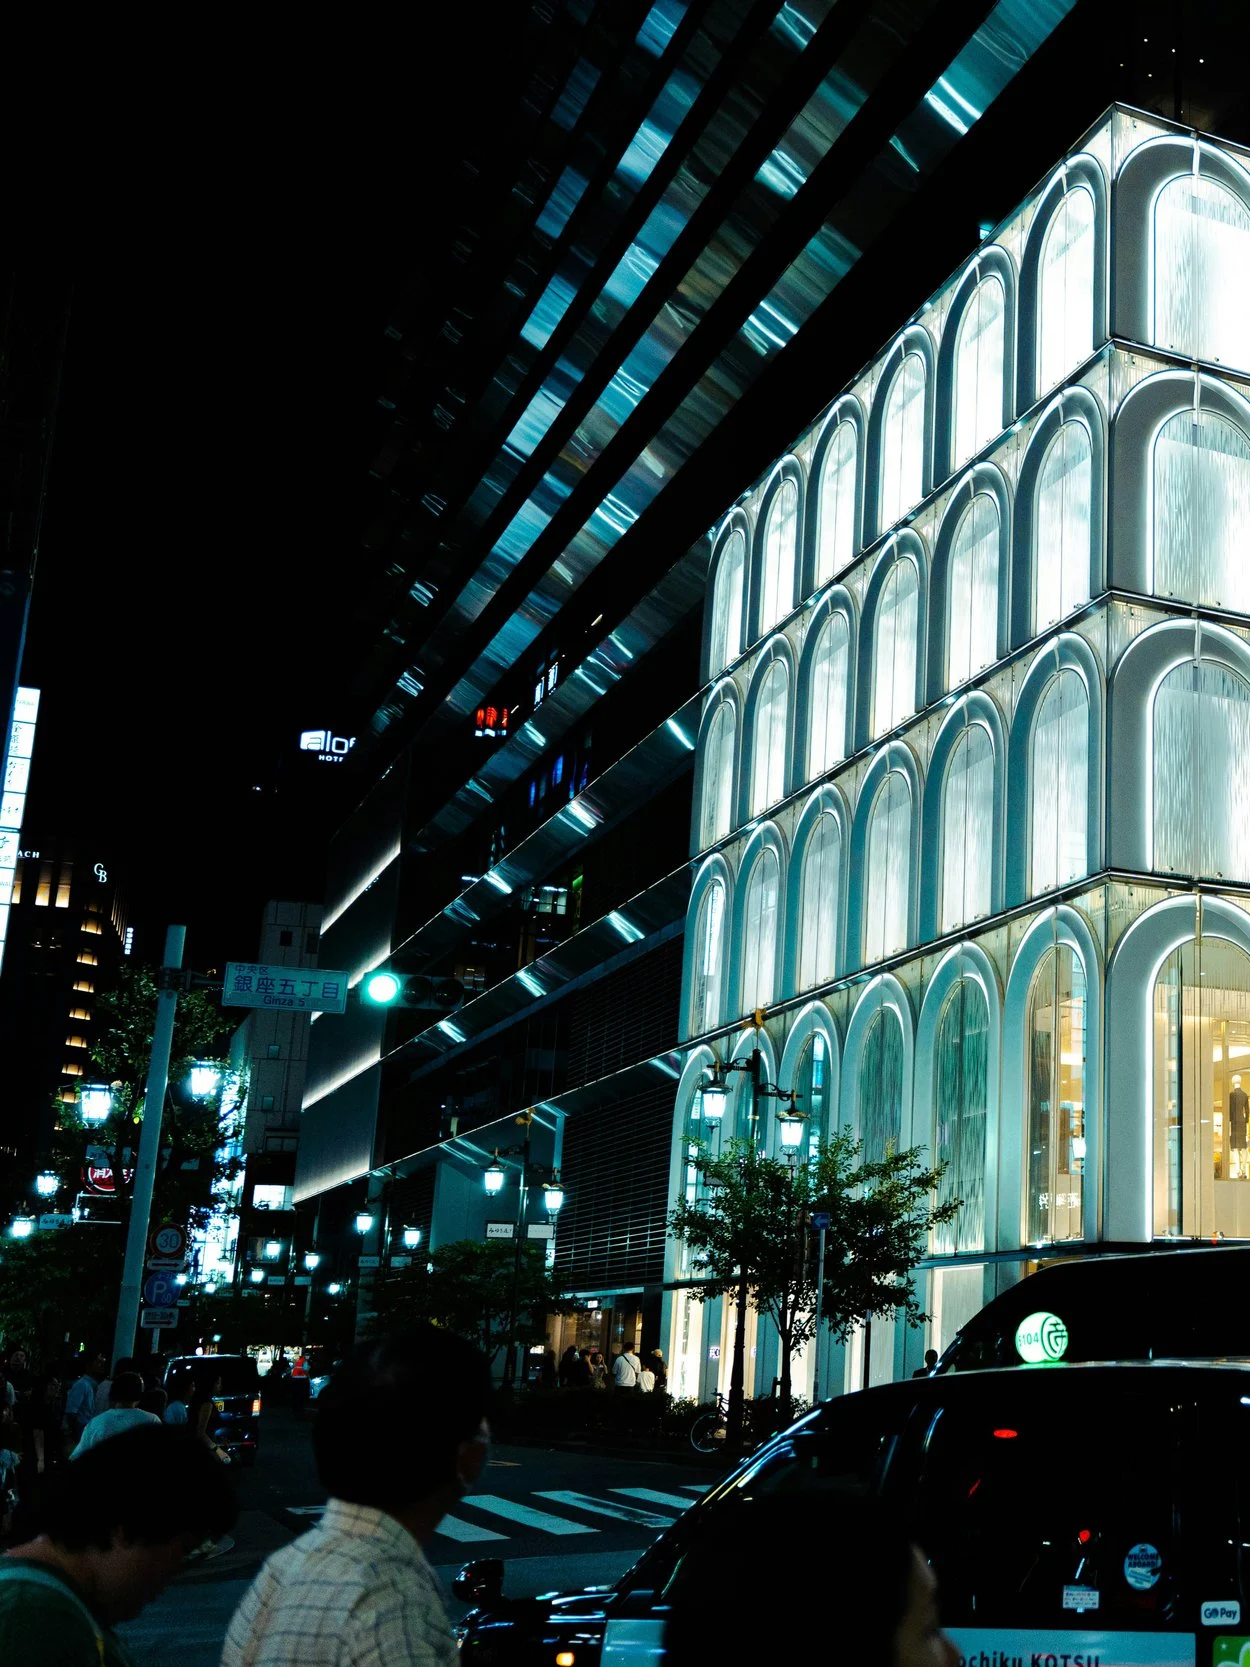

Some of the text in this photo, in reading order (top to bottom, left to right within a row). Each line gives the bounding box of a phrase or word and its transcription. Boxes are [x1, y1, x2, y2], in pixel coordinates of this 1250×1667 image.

[299, 730, 357, 754] alof
[18, 851, 41, 859] ACH
[235, 965, 268, 974] 中央区
[233, 974, 338, 999] 銀座五丁目
[263, 994, 305, 1007] Ginza 5
[159, 1234, 179, 1249] 30
[152, 1280, 167, 1304] P
[1220, 1607, 1237, 1620] Pay
[957, 1650, 1022, 1667] ochiku
